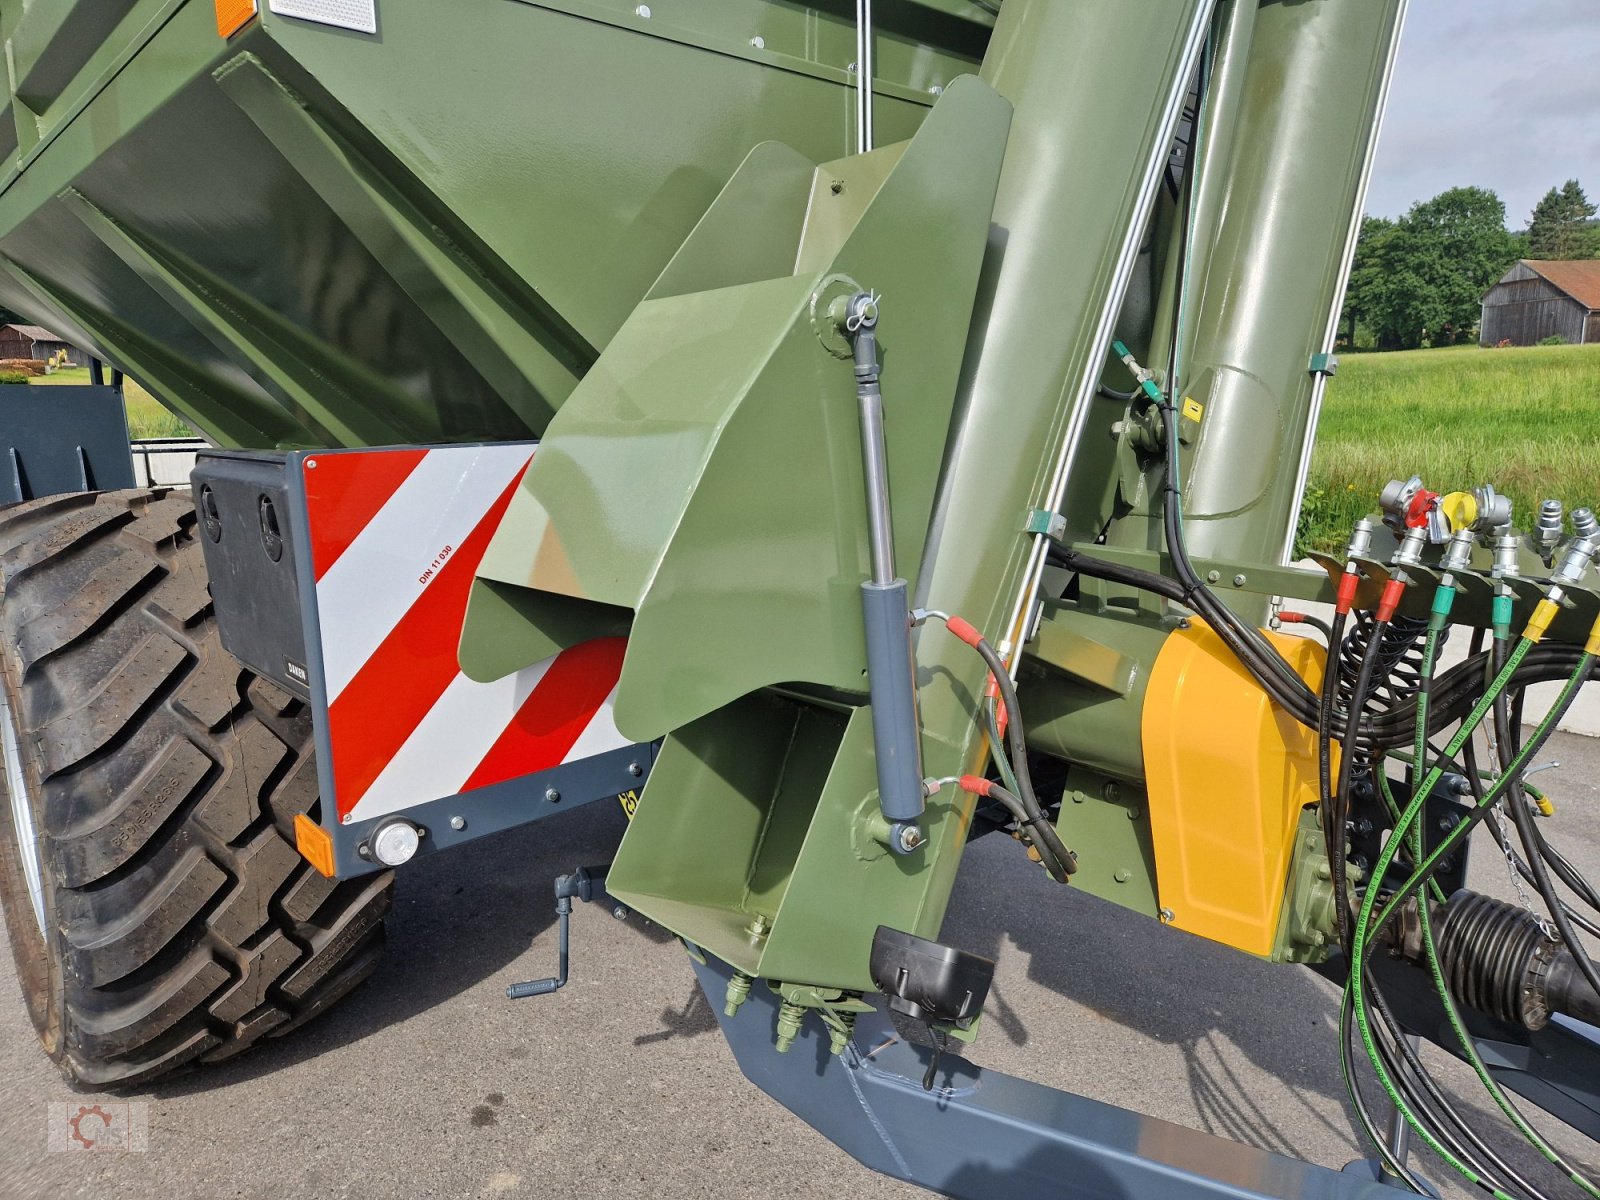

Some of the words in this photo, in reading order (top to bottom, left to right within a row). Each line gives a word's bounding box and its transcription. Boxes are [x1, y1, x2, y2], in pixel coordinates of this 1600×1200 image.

[418, 568, 434, 585] DIN
[431, 559, 441, 569] 11
[438, 545, 452, 560] 030
[1506, 655, 1519, 669] SAE
[1499, 667, 1511, 680] 100
[1489, 676, 1505, 693] R2AT
[1473, 693, 1493, 716] ARGUS
[1450, 732, 1465, 750] ITALY
[1450, 1157, 1470, 1175] ITALY
